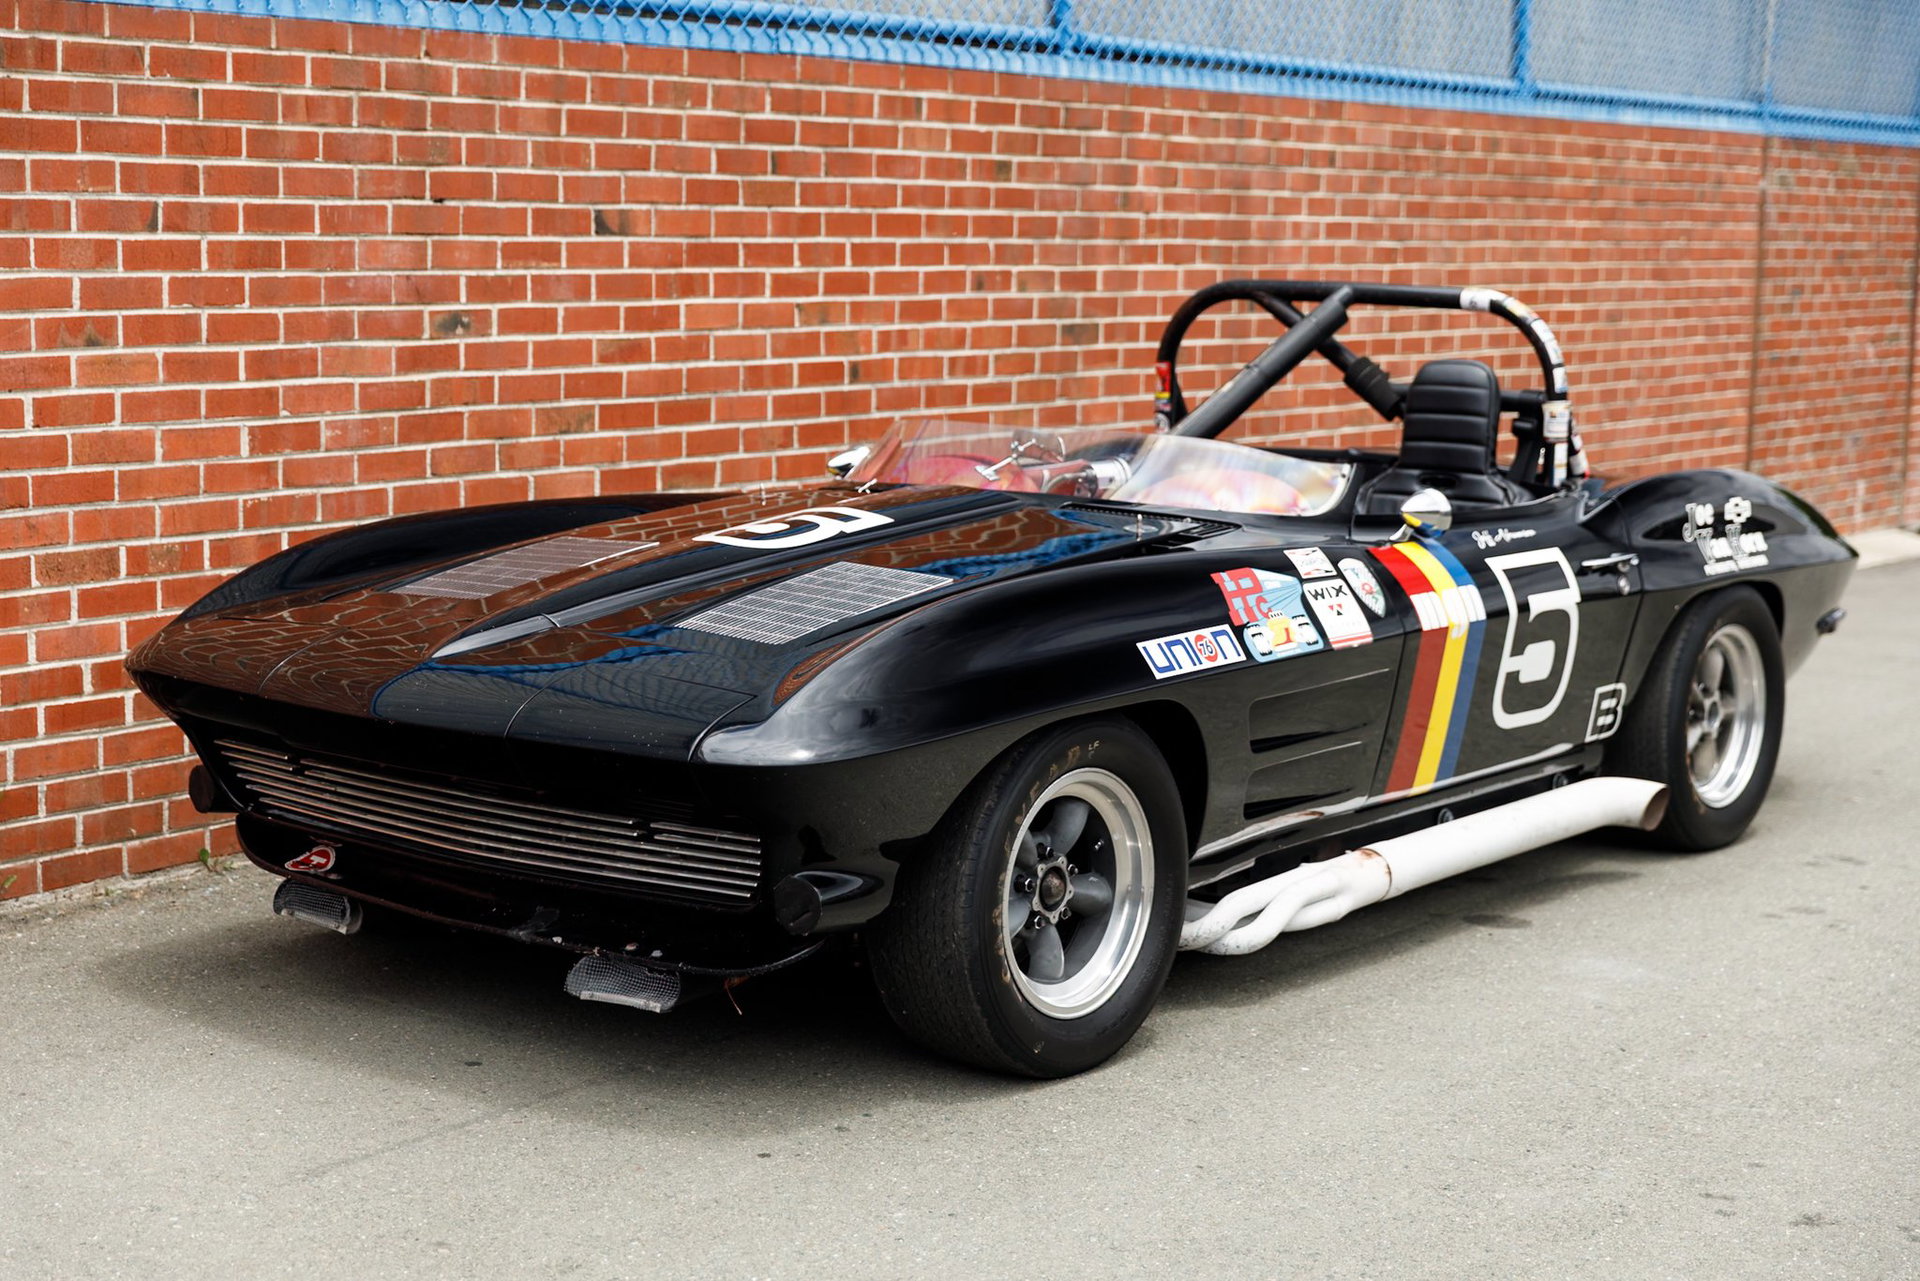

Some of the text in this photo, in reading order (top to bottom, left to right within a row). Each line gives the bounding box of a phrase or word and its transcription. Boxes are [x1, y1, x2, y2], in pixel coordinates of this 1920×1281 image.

[1307, 585, 1348, 601] WIX
[1484, 546, 1582, 729] 5
[1585, 682, 1627, 743] B
